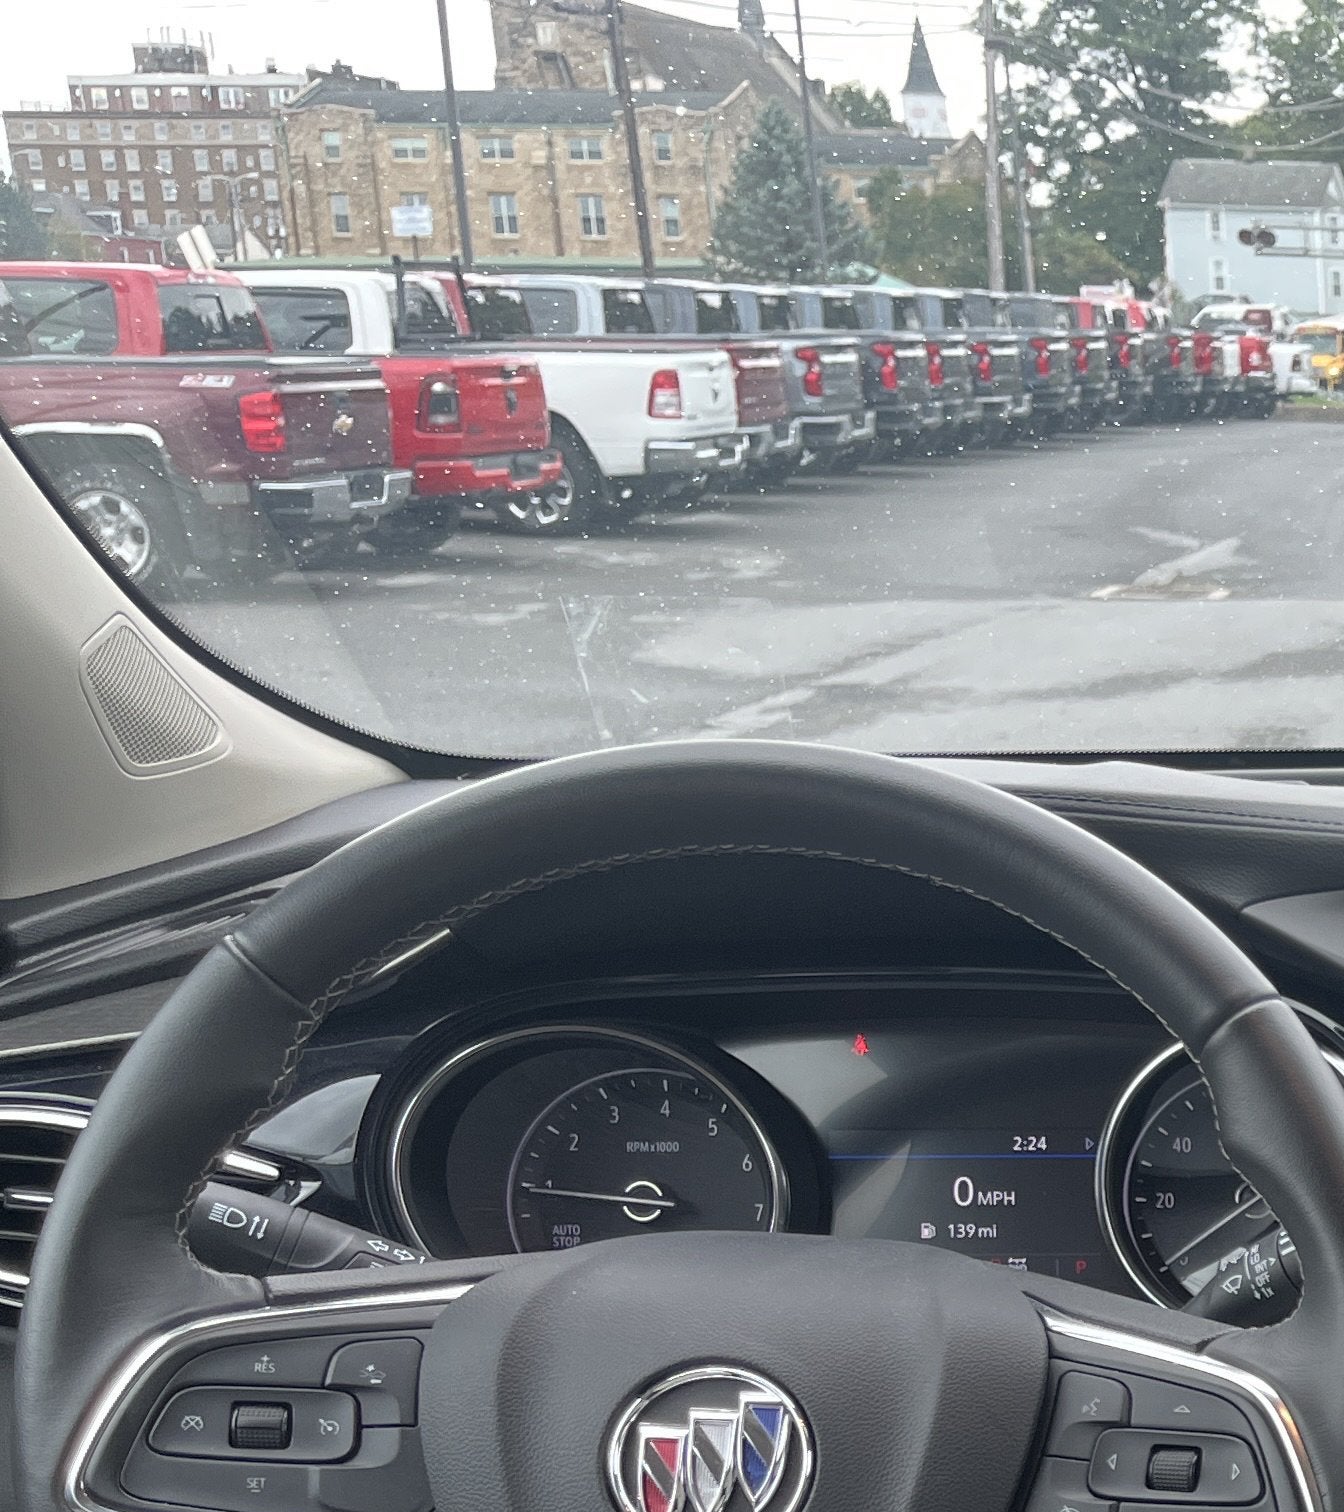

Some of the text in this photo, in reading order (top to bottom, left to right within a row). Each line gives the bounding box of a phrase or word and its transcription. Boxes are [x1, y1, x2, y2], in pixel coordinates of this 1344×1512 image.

[609, 1105, 620, 1124] 3
[660, 1100, 671, 1118] 4
[707, 1118, 718, 1137] 5
[569, 1133, 580, 1152] 2
[1012, 1136, 1047, 1151] 2:24
[1172, 1136, 1192, 1153] 40
[742, 1153, 753, 1172] 6
[953, 1176, 1016, 1207] 0 MPH
[1155, 1192, 1175, 1210] 20
[754, 1204, 764, 1221] 7
[552, 1224, 581, 1236] AUTO
[948, 1223, 997, 1238] 139 mi
[552, 1236, 581, 1248] STOP
[254, 1361, 275, 1374] RES
[246, 1477, 266, 1489] SET
